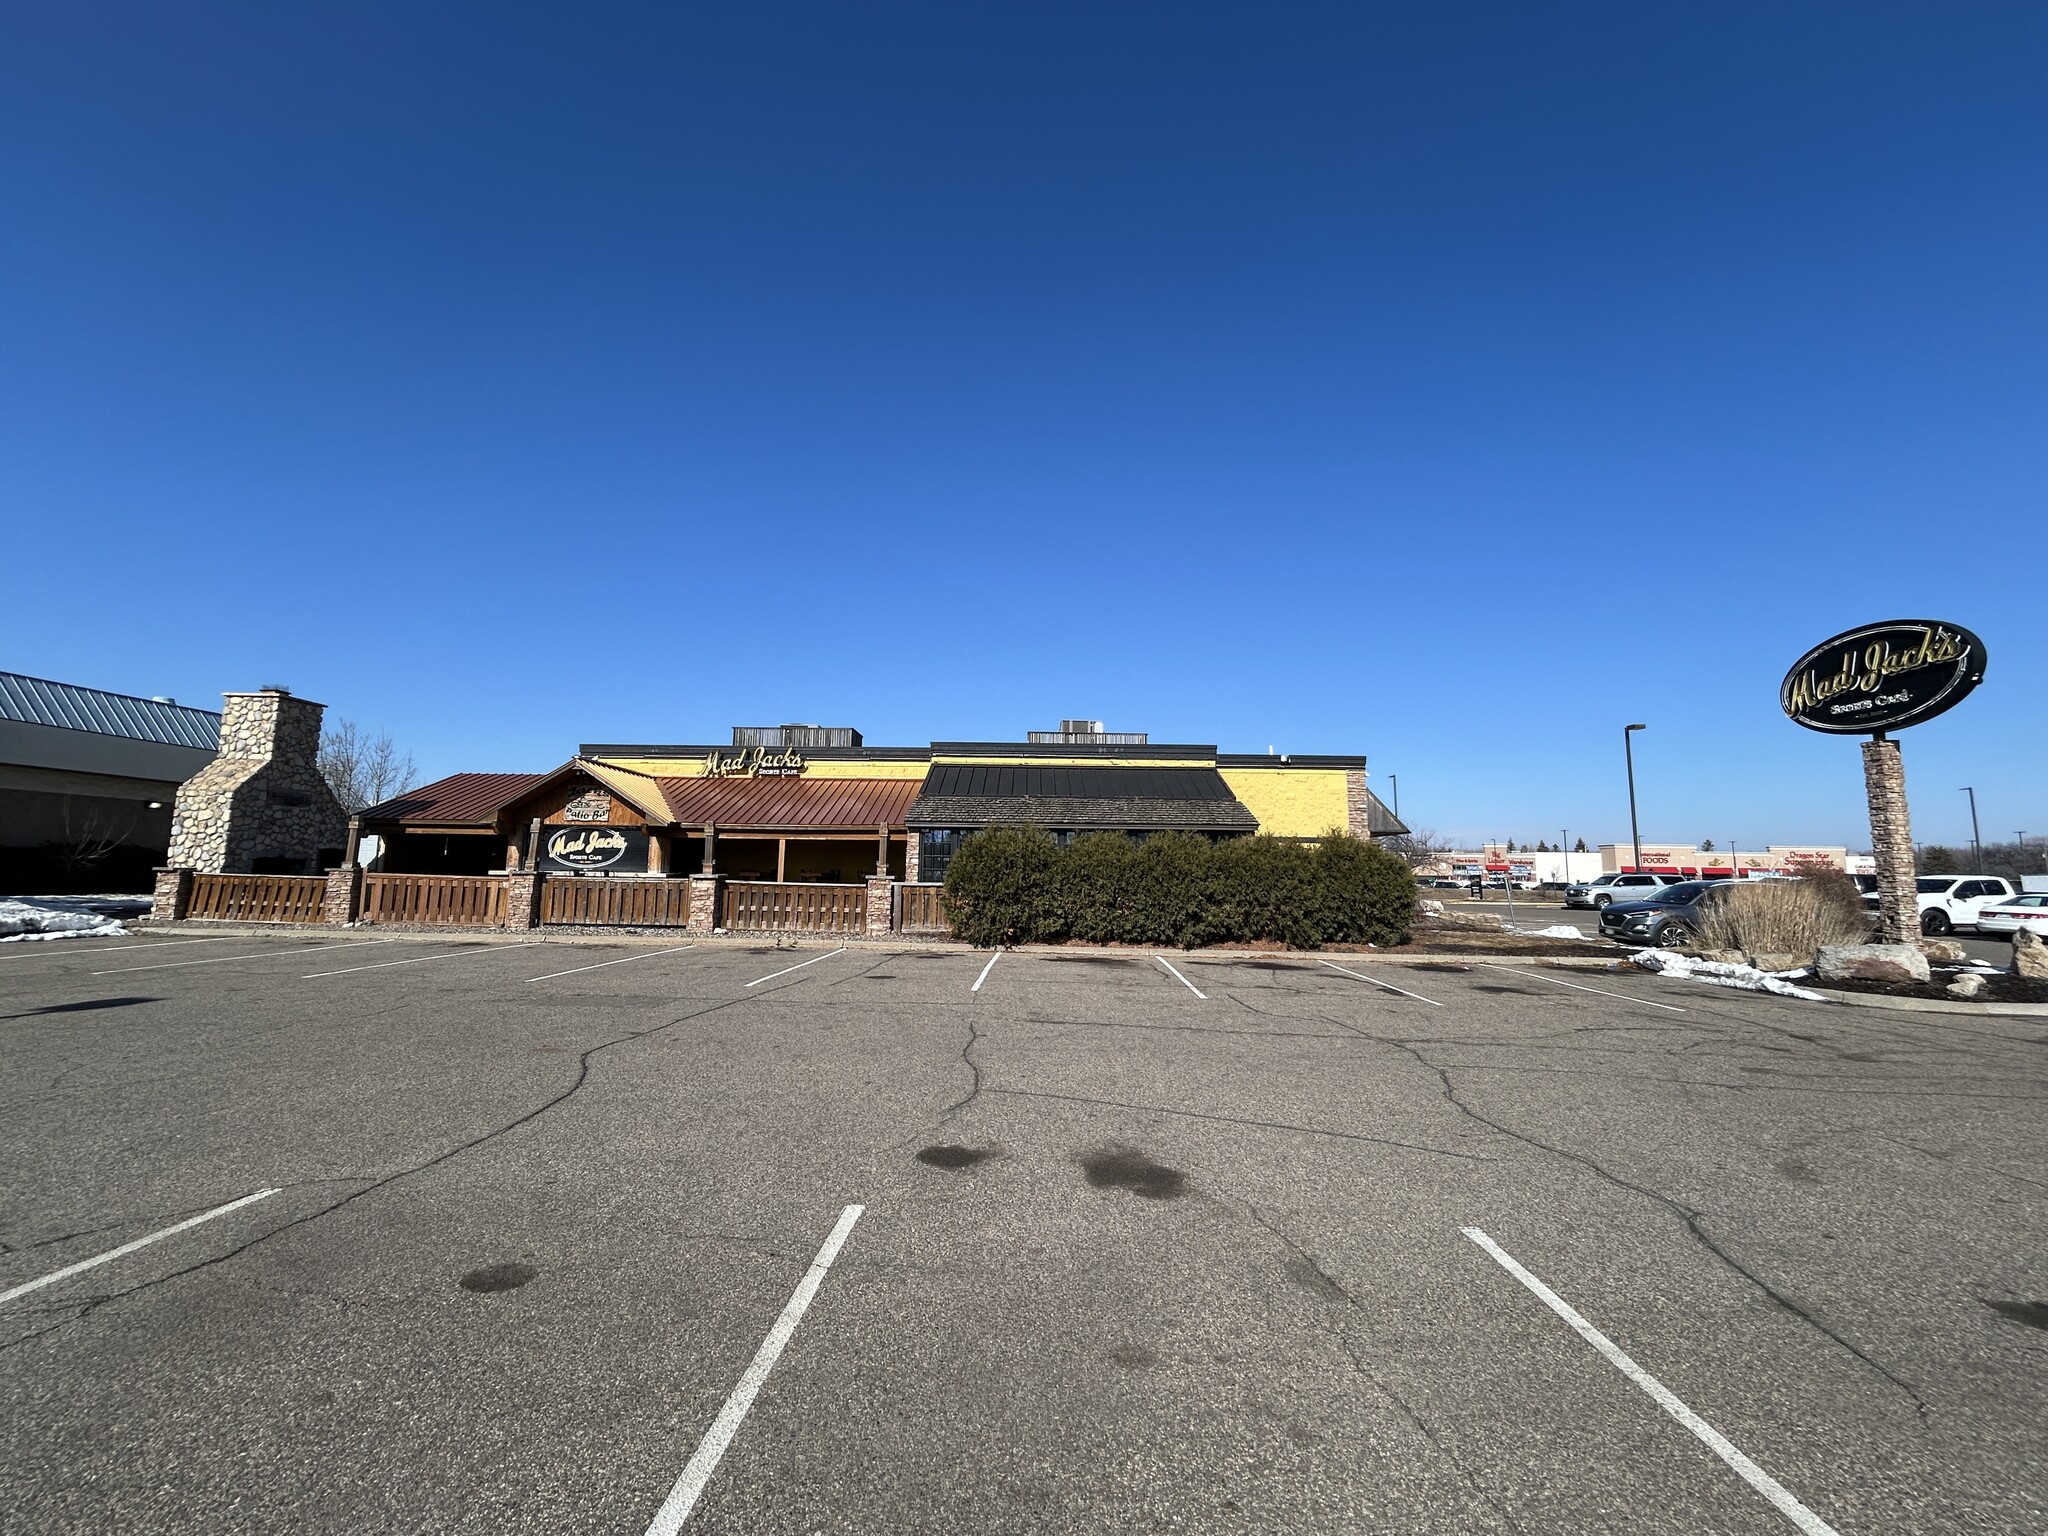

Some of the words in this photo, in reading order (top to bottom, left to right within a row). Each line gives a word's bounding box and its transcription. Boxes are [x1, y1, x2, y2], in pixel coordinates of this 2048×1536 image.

[1787, 651, 1860, 718] Mad
[697, 748, 747, 778] Mad
[565, 808, 589, 819] Patio
[591, 809, 608, 820] Bar
[549, 832, 586, 858] Mad
[1789, 851, 1814, 860] Dragon
[1815, 851, 1830, 859] Star
